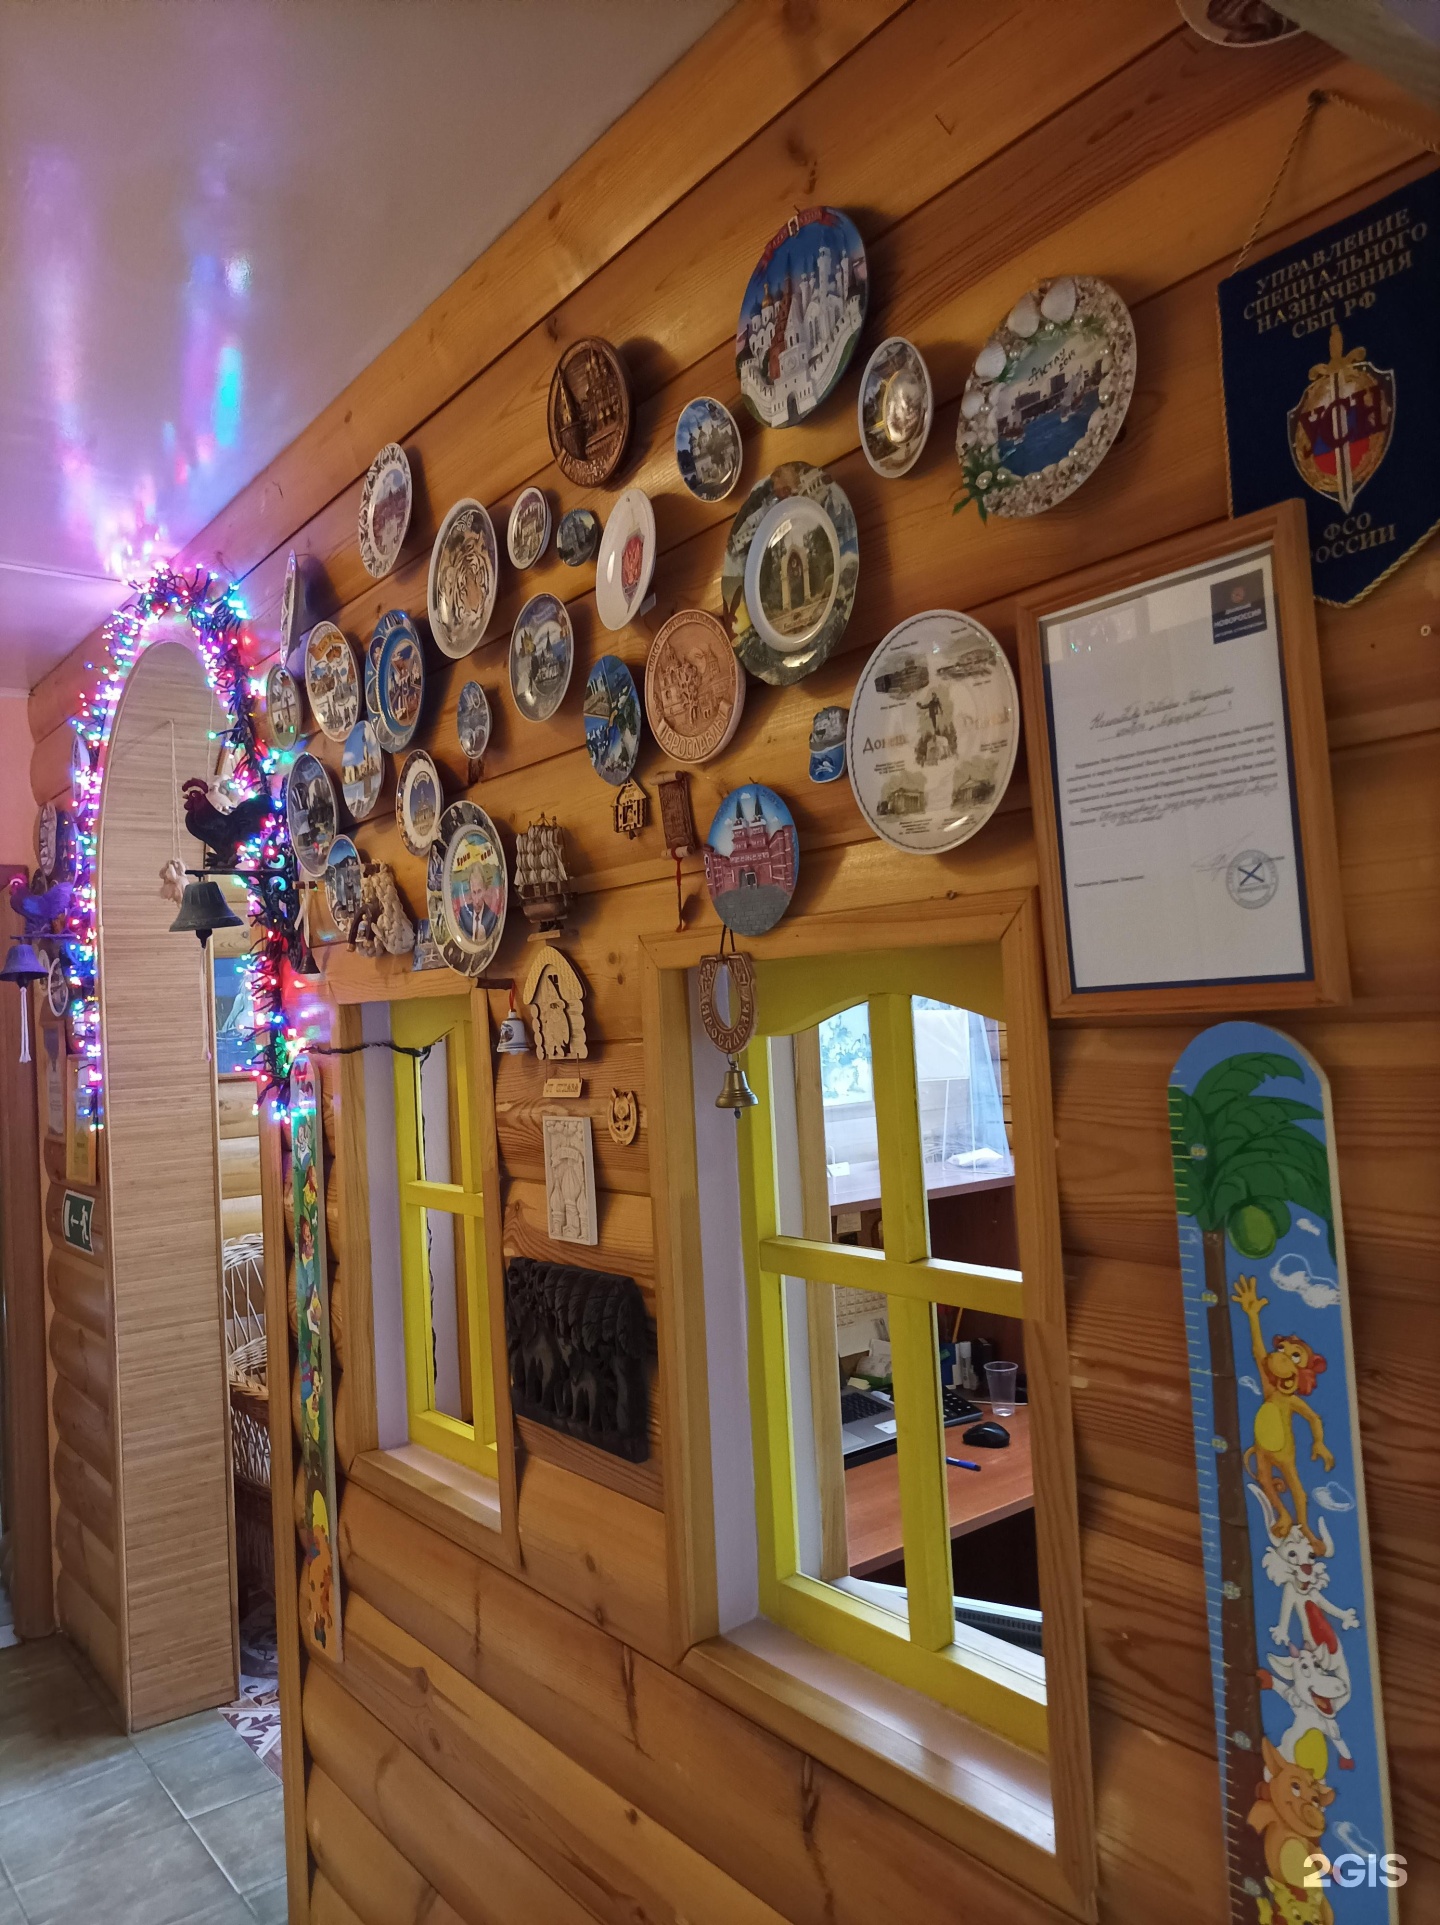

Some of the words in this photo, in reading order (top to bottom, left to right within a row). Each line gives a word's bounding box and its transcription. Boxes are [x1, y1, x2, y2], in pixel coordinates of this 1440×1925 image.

[1243, 222, 1428, 320] СПЕЦИАЛЬНОГО
[1256, 208, 1411, 294] УПРАВЛЕНИЕ
[1257, 250, 1413, 334] НАЗНАЧЕНИЯ
[1292, 307, 1336, 338] СБП
[1344, 290, 1377, 318] РФ
[1311, 523, 1396, 564] ОССИИ
[1323, 512, 1371, 541] ФСО
[664, 715, 728, 759] ЯРОСЛАВЛЬ
